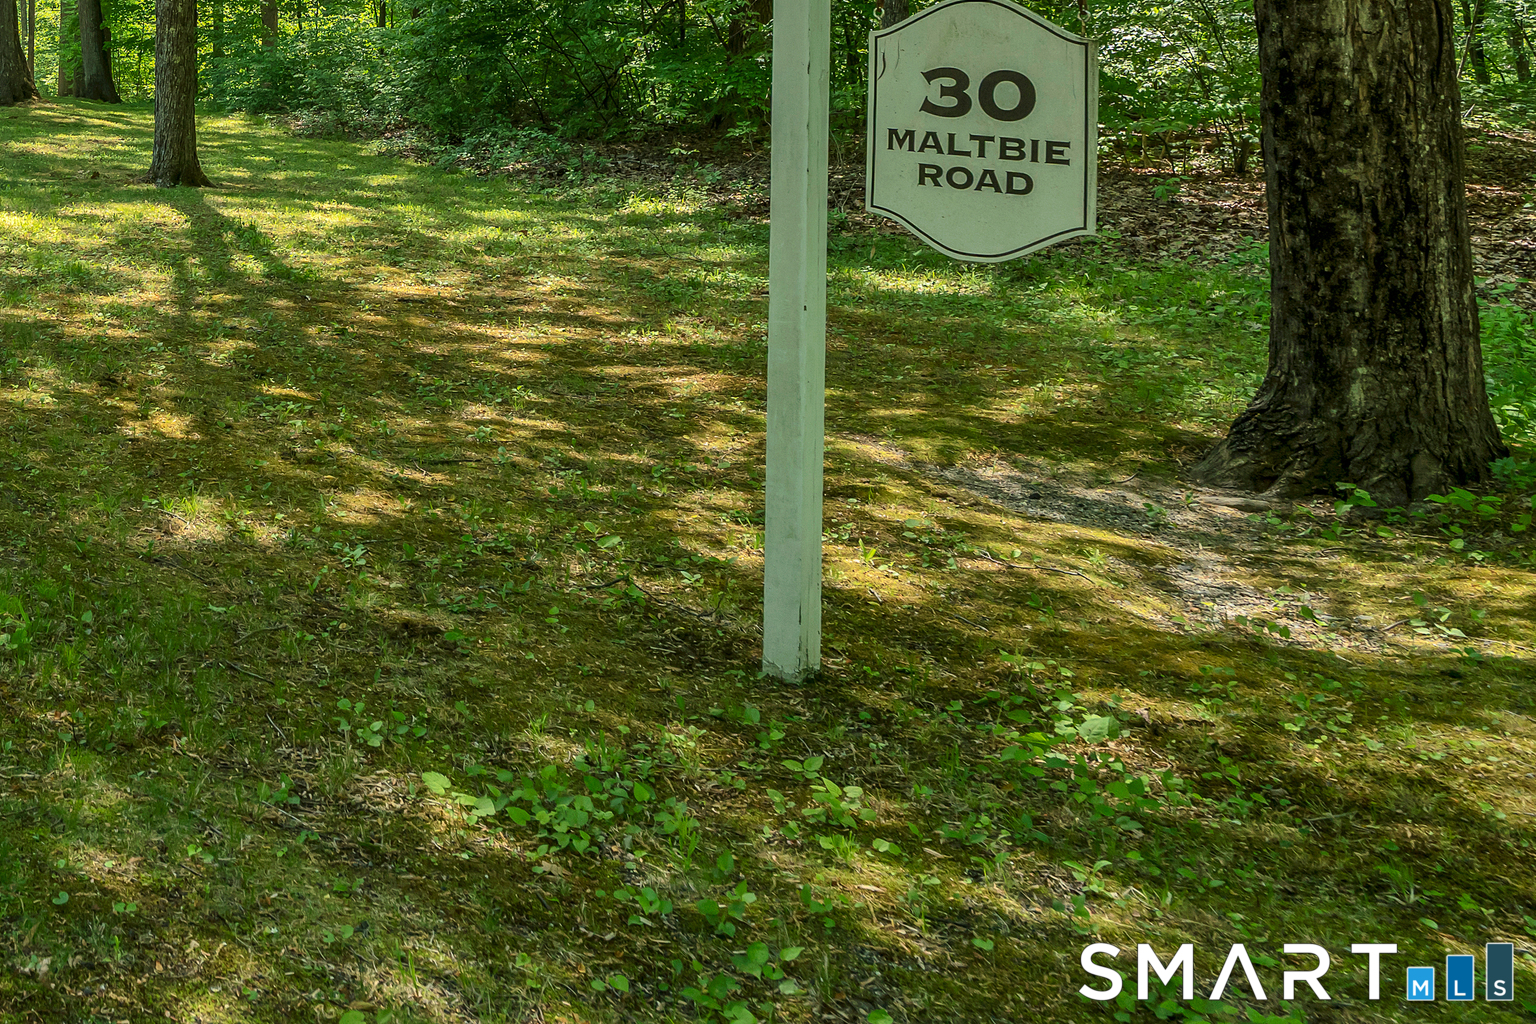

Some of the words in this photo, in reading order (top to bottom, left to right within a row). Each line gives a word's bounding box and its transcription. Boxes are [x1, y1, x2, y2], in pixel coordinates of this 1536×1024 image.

[919, 67, 1036, 121] 30
[887, 128, 1071, 166] MALTBIE
[918, 163, 1034, 195] ROAD
